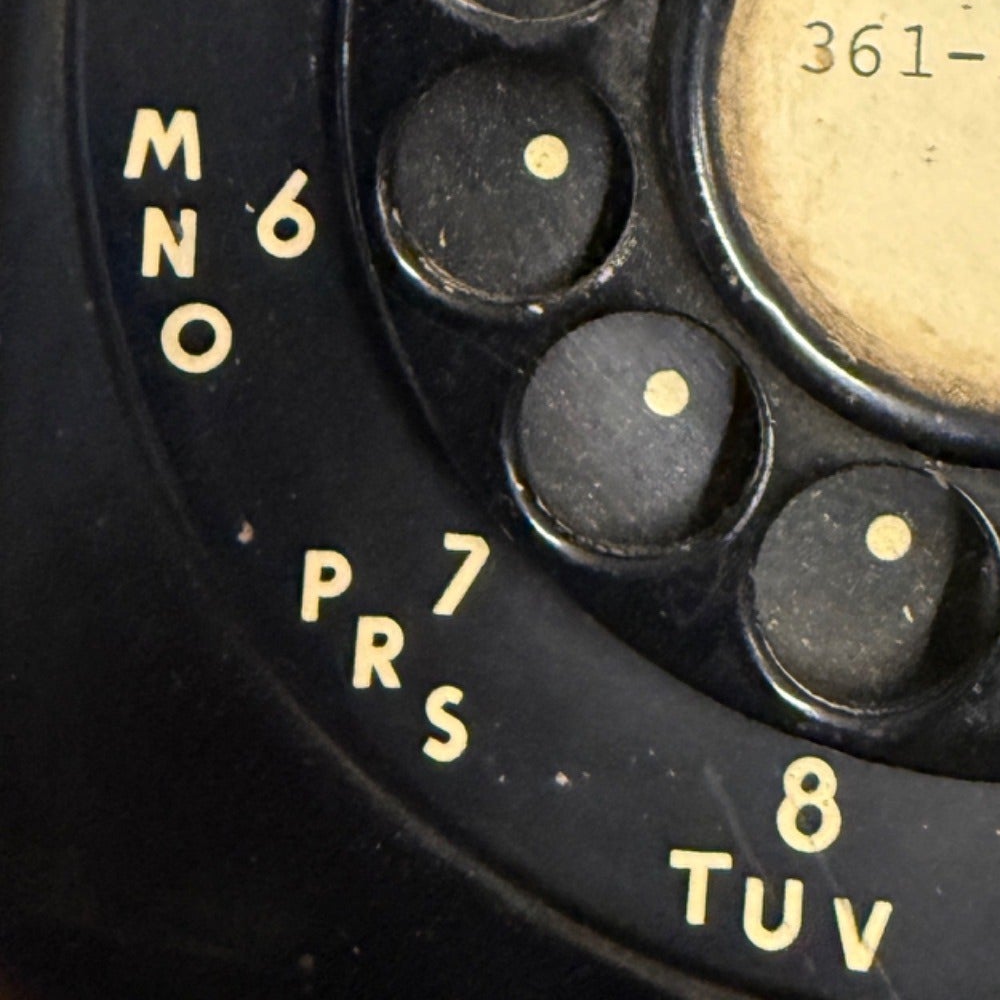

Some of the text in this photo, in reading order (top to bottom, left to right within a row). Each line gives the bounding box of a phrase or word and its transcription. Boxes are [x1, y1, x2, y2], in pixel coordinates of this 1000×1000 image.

[257, 169, 315, 258] 6
[433, 532, 490, 615] 7
[777, 756, 842, 853] 8
[669, 850, 893, 971] TUV
